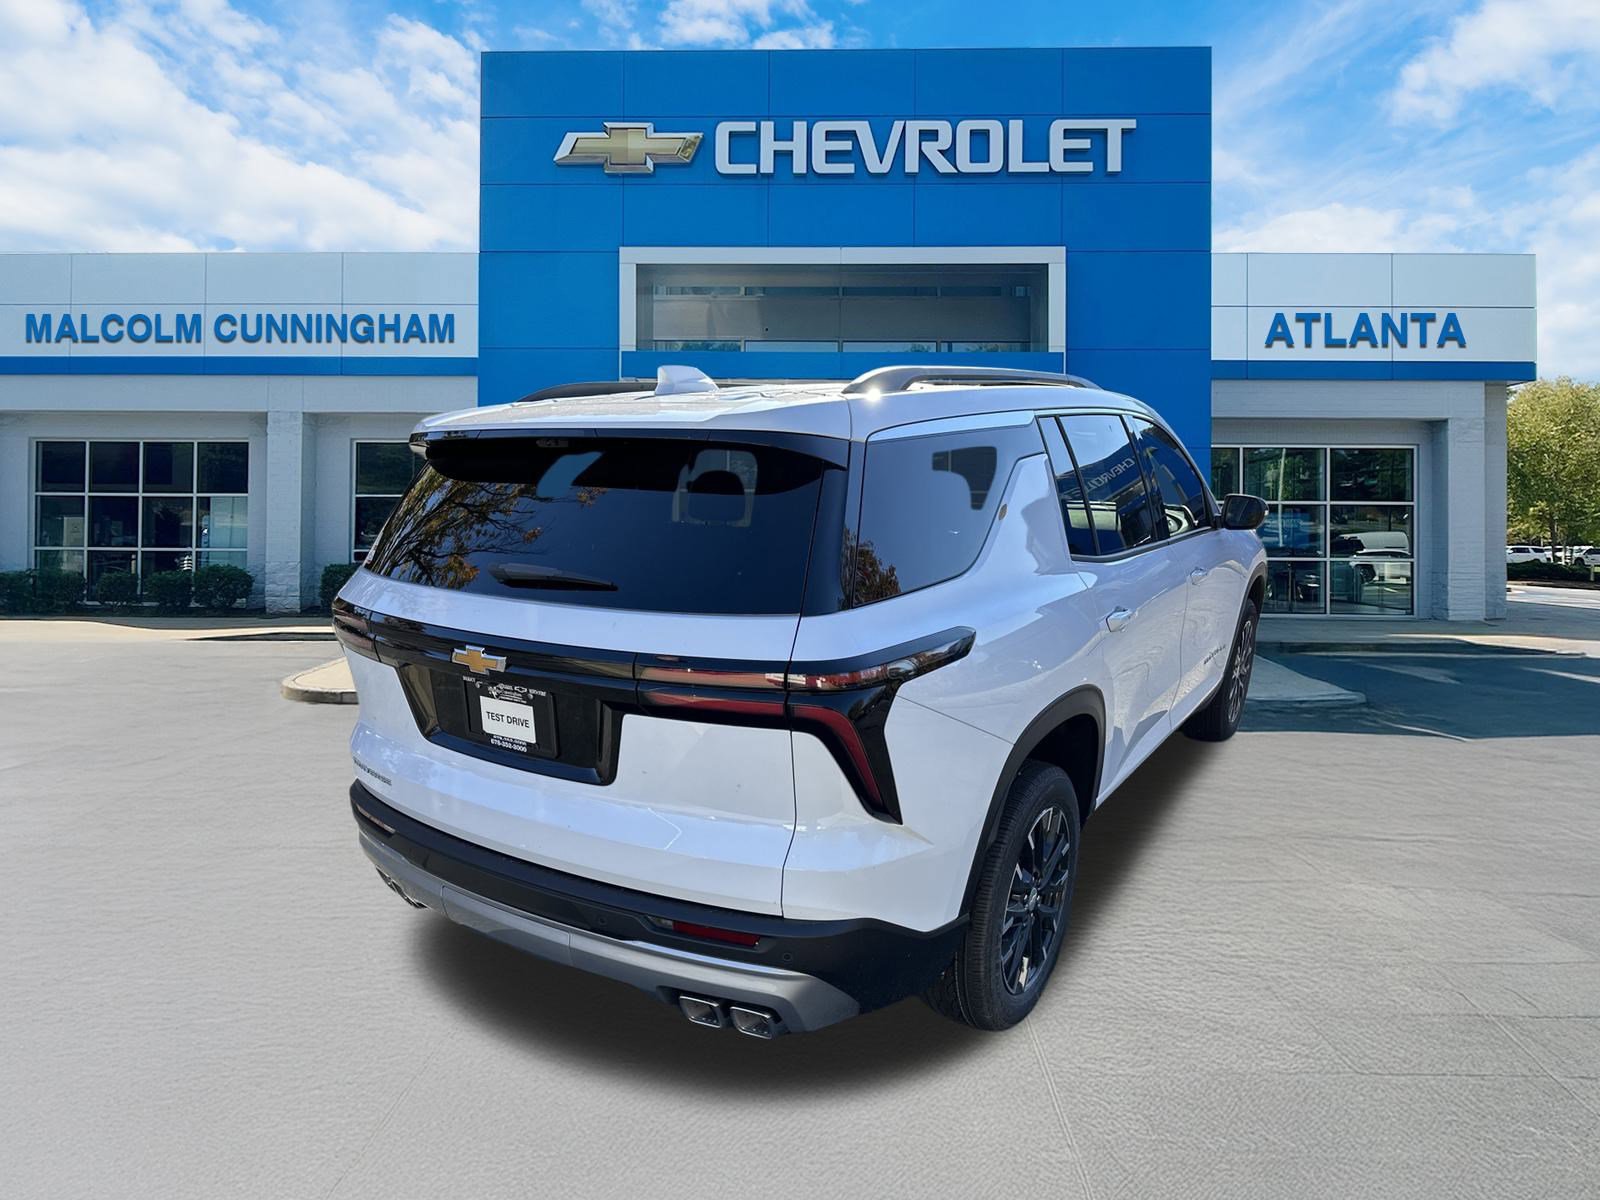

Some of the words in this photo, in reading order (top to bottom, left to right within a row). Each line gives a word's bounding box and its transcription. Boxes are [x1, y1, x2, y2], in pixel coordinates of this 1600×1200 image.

[714, 118, 1137, 175] CHEVROLET
[25, 313, 202, 343] MALCOLM
[213, 313, 455, 343] CUNNINGHAM
[1264, 312, 1467, 348] ATLANTA
[486, 711, 505, 723] TEST
[506, 715, 530, 728] DRIVE
